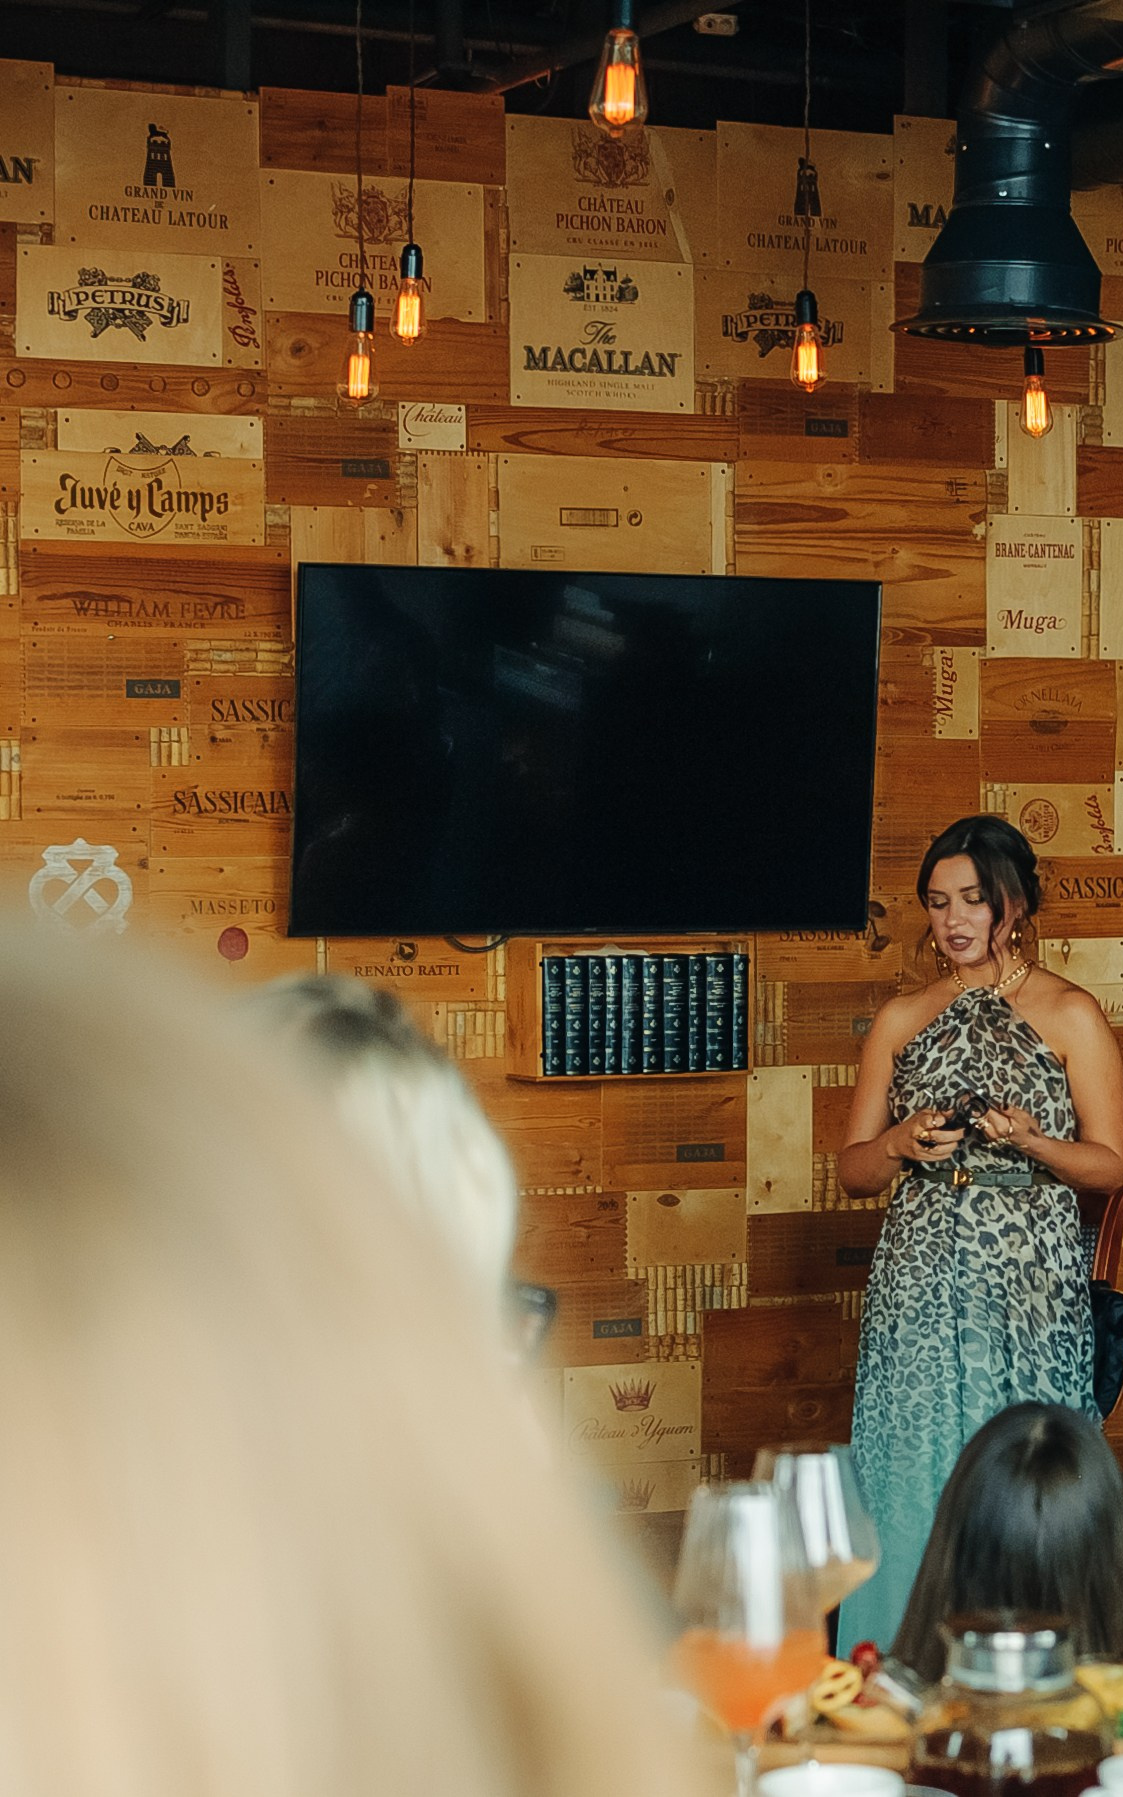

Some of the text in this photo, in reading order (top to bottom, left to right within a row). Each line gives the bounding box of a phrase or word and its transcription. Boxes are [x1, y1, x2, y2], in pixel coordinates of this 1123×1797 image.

[125, 185, 194, 202] GRAND VIN
[577, 193, 645, 215] CHÂTEAU
[88, 204, 229, 231] CHATEAU LATOUR
[555, 212, 667, 237] PICHON BARON
[777, 214, 838, 230] GRAND VIN
[746, 232, 868, 256] CHATEAU LATOUR
[338, 251, 402, 272] CHÂTEA
[315, 270, 433, 294] PICHON BAN
[73, 291, 164, 310] PETRUS
[579, 320, 616, 345] The
[523, 345, 678, 378] MACALLAN
[547, 378, 655, 391] HIGHLAND SINGLE MALT
[566, 389, 637, 400] SCOTCH WHISKY
[54, 472, 229, 524] Juvé y Camps
[127, 521, 156, 533] CAVA
[70, 599, 171, 619] WILLIAM
[107, 620, 154, 629] CHABLIS
[163, 621, 206, 630] FRANCE
[996, 609, 1067, 635] Muga
[134, 683, 173, 696] GAJA
[935, 648, 958, 728] Muga
[1013, 686, 1084, 714] ORNELLAIA
[211, 698, 295, 724] SASSIC
[172, 790, 292, 815] SASSICAIA
[190, 899, 276, 915] MASSETO
[354, 963, 460, 979] RENATO RATTI
[599, 1321, 635, 1335] GAJA
